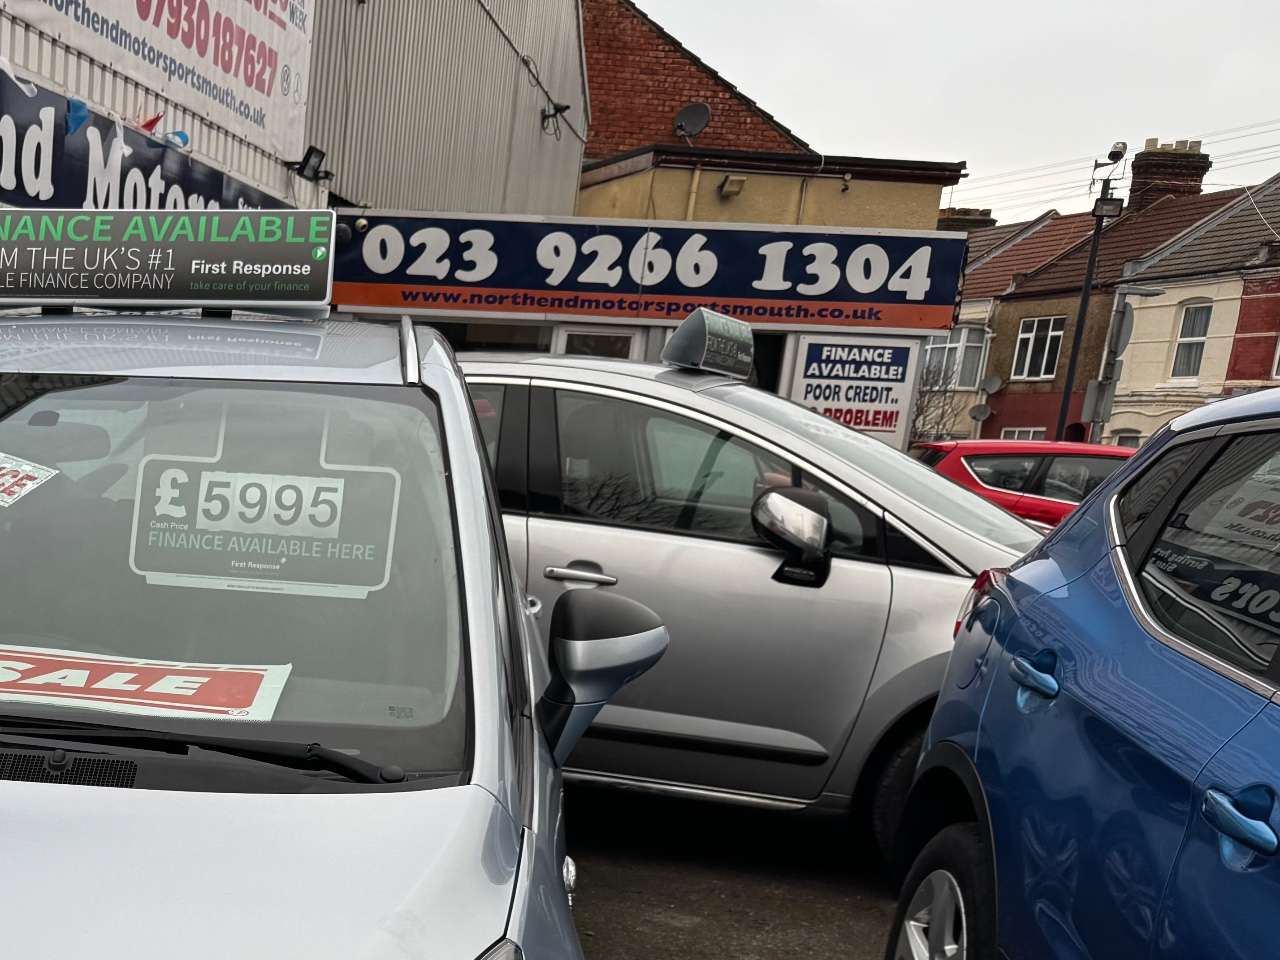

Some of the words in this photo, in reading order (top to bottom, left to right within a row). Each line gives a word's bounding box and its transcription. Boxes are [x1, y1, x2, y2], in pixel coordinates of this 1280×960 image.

[82, 126, 220, 209] Moto
[122, 214, 331, 243] AVAILABLE
[26, 247, 76, 270] THE
[147, 248, 176, 271] #1
[361, 224, 498, 283] 023
[535, 231, 718, 288] 9266
[751, 240, 932, 300] 1304
[191, 260, 227, 275] First
[232, 260, 311, 278] Response
[19, 272, 89, 289] FINANCE
[93, 273, 175, 290] COMPANY
[274, 281, 310, 292] finance
[821, 346, 893, 362] FINANCE
[806, 362, 903, 380] AVAILABLE!
[804, 383, 842, 401] POOR
[148, 530, 224, 551] FINANCE
[227, 536, 321, 557] AVAILABLE
[327, 543, 375, 560] HERE
